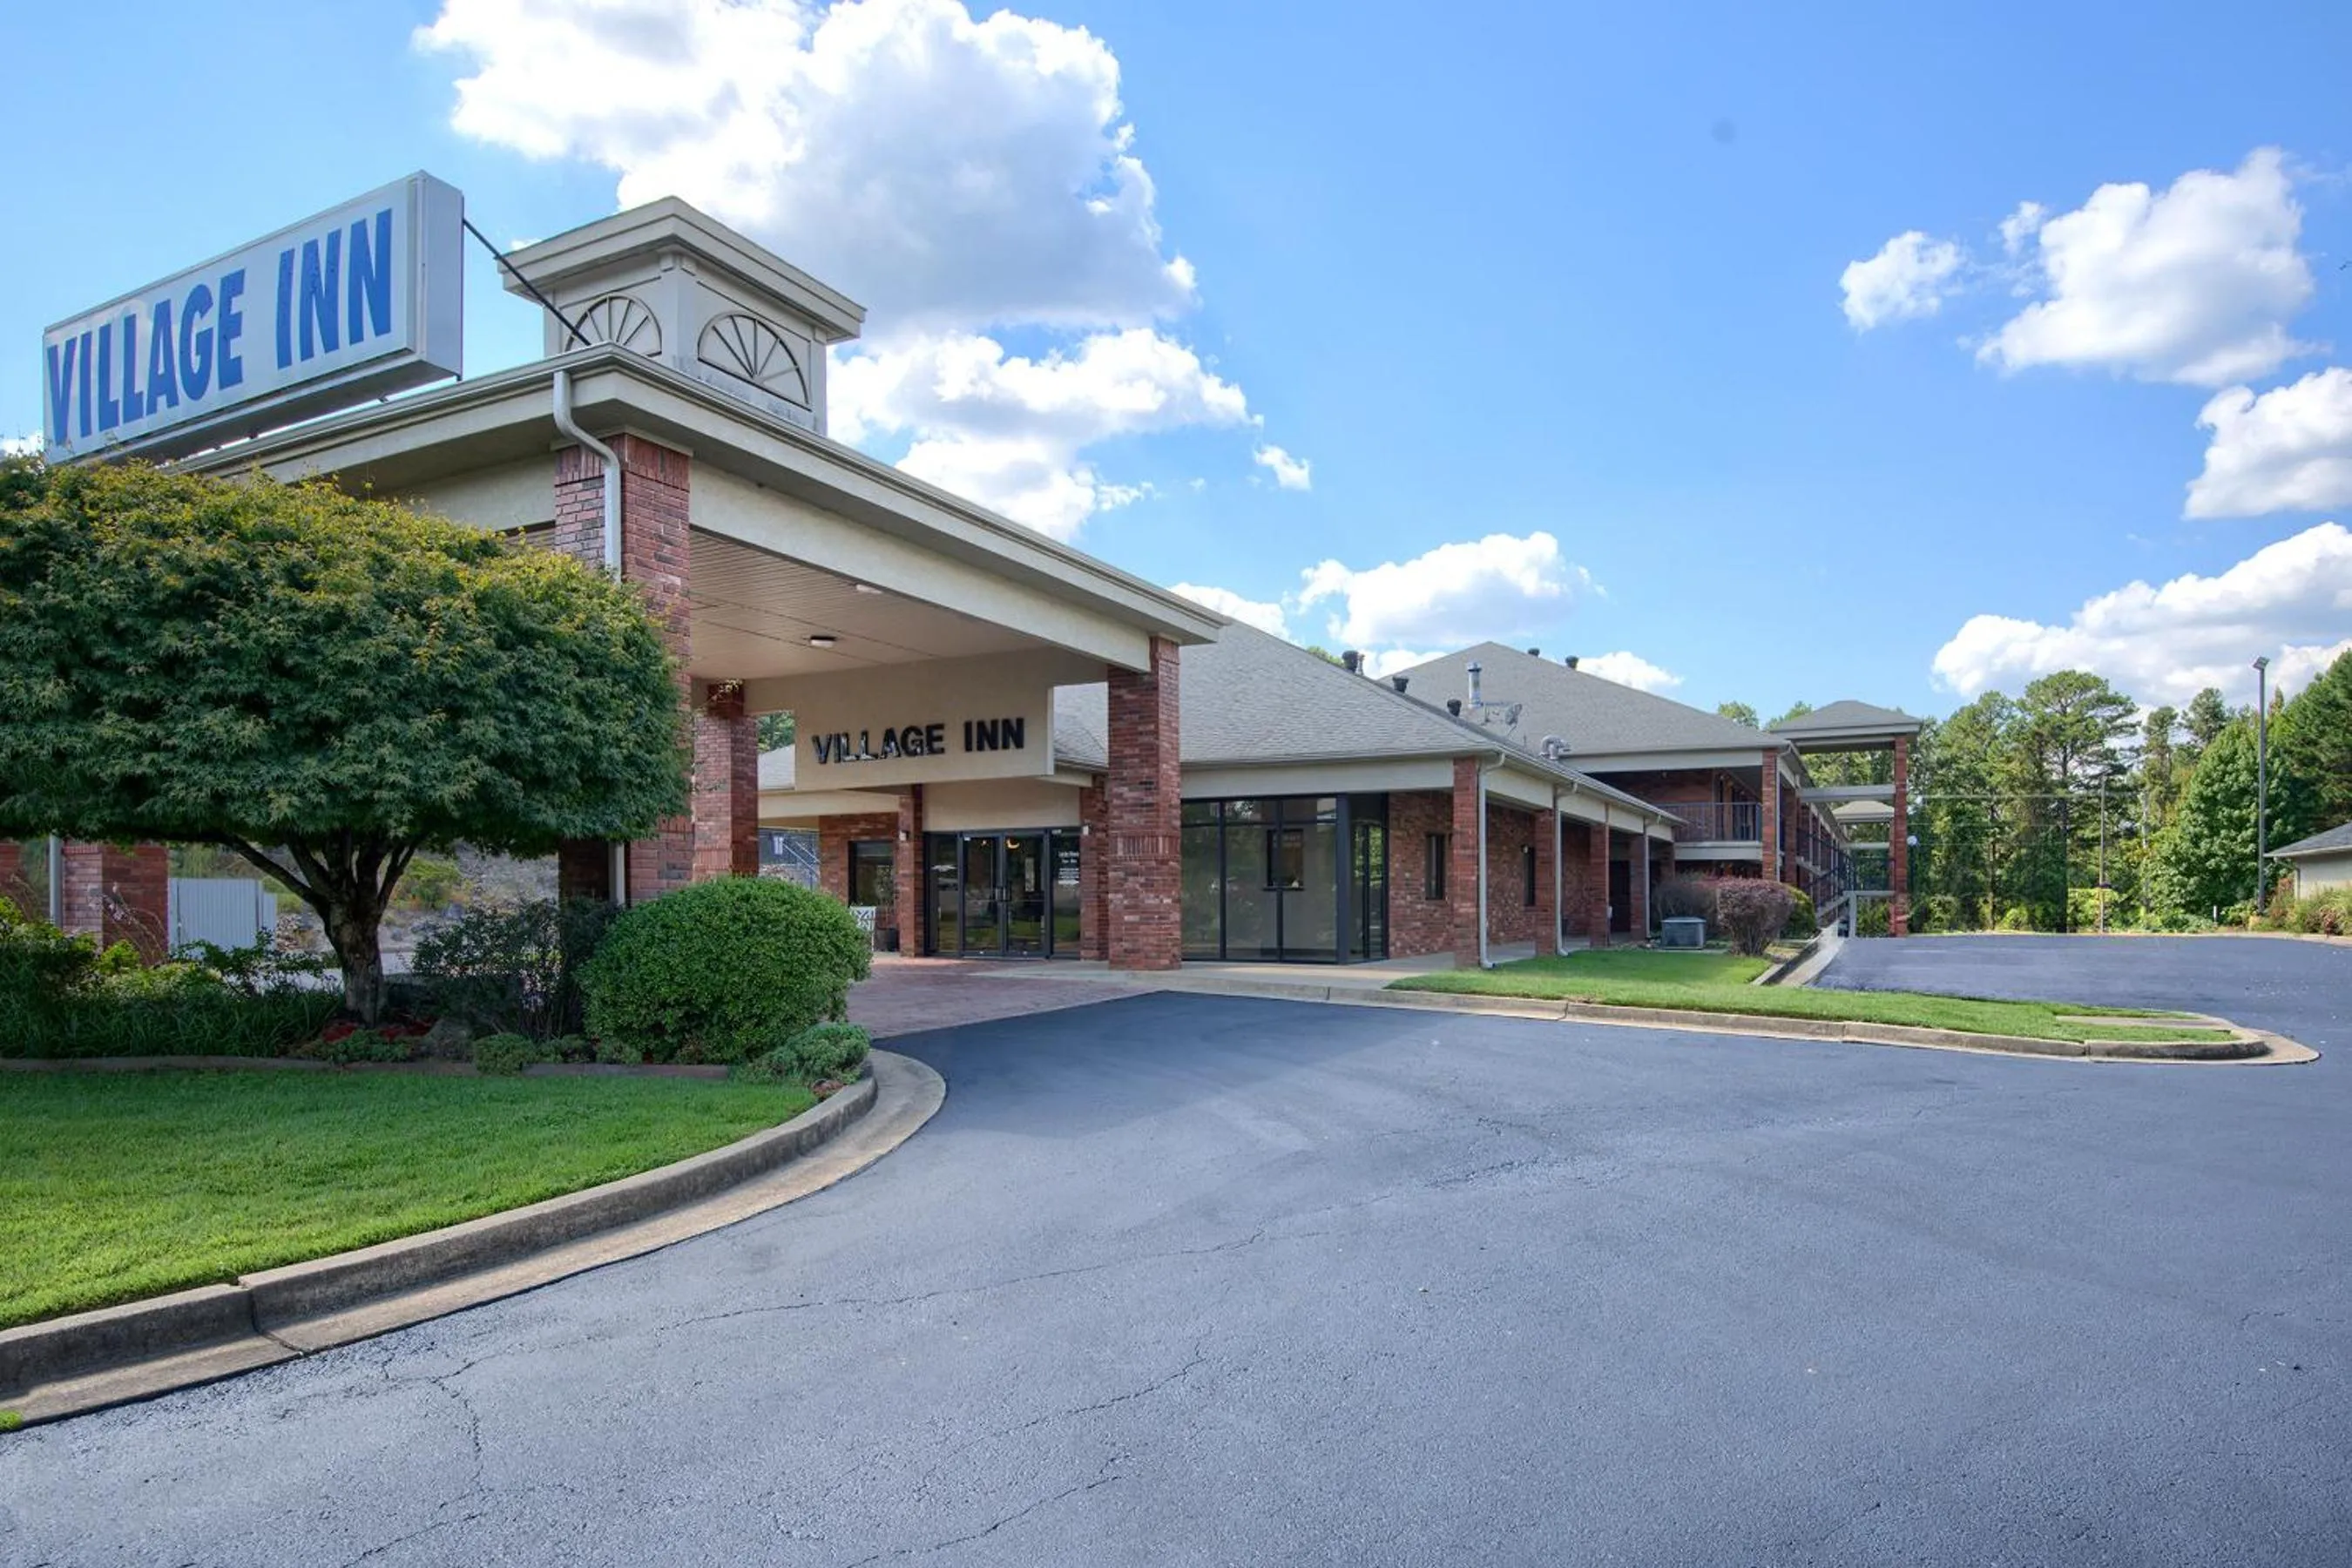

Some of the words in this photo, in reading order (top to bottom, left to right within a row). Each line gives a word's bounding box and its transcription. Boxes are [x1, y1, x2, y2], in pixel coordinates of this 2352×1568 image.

[47, 268, 245, 445] VILLAGE
[276, 208, 391, 369] INN
[812, 724, 945, 764] VILLAGE
[964, 718, 1024, 752] INN
